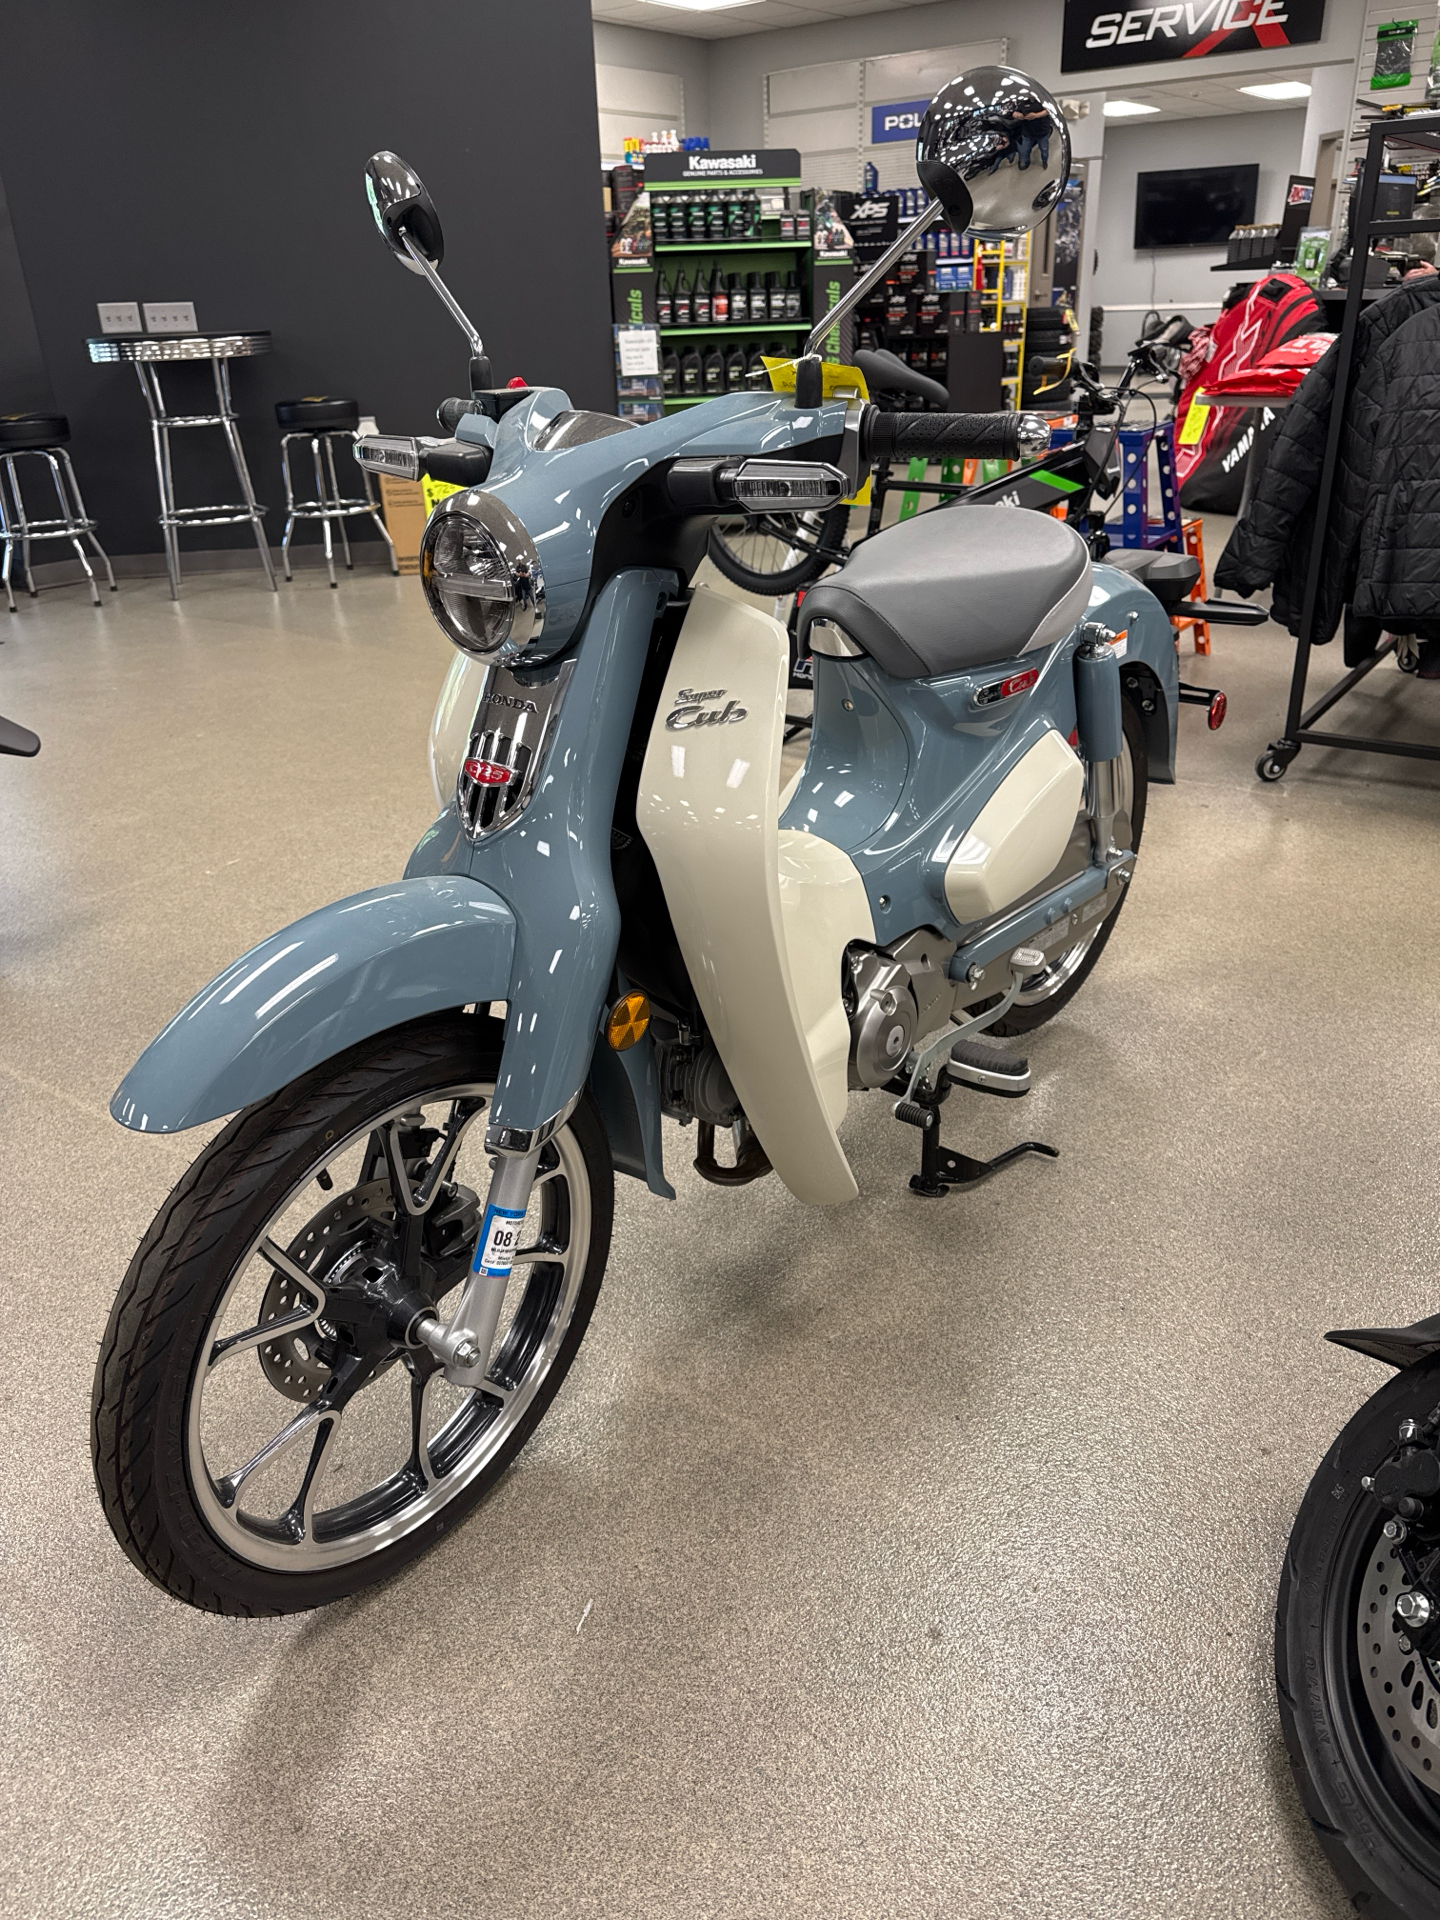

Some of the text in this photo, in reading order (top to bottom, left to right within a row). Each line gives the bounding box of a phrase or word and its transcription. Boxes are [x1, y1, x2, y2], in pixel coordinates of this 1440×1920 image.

[1085, 0, 1289, 49] SERVICE
[688, 154, 757, 170] Kawasaki
[850, 200, 890, 219] XPS
[483, 692, 539, 713] HONDA
[675, 688, 727, 704] Super
[666, 700, 749, 730] Cub
[494, 1208, 509, 1216] NEW
[493, 1230, 513, 1247] 08
